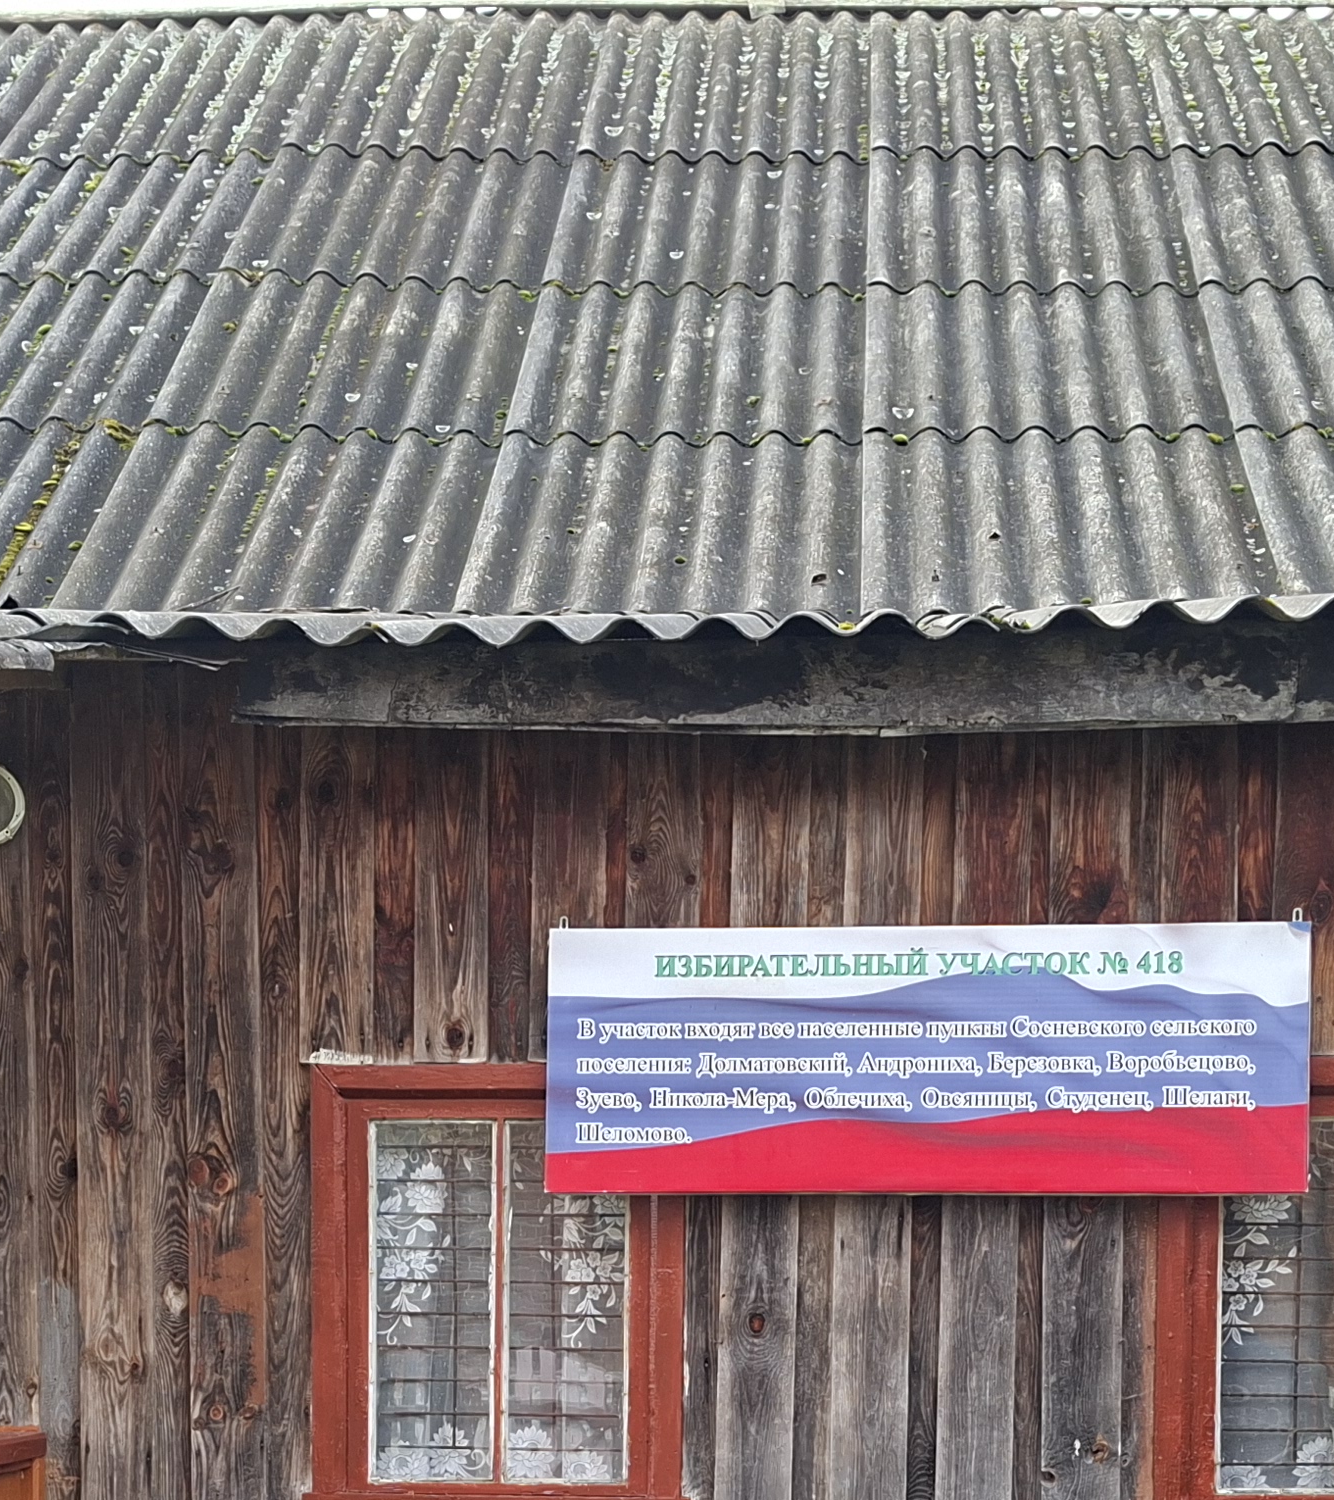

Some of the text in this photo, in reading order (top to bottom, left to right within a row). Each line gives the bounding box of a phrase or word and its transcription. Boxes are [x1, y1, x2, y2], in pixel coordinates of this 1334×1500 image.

[654, 946, 1184, 978] ИЗБИРАТЕЛЬНЫЙ УЧАСТОК № 418
[579, 1017, 1256, 1042] В участок входят все населенные пункты Сосневского сельского
[578, 1051, 1256, 1077] поселения: Долматовский, Андрониха, Березовка, Воробьецово,
[576, 1086, 1256, 1112] Зуево, Никола-Мера, Облечиха, Овсяницы, Студенец, Шелаги,
[576, 1123, 693, 1143] Шеломово.
